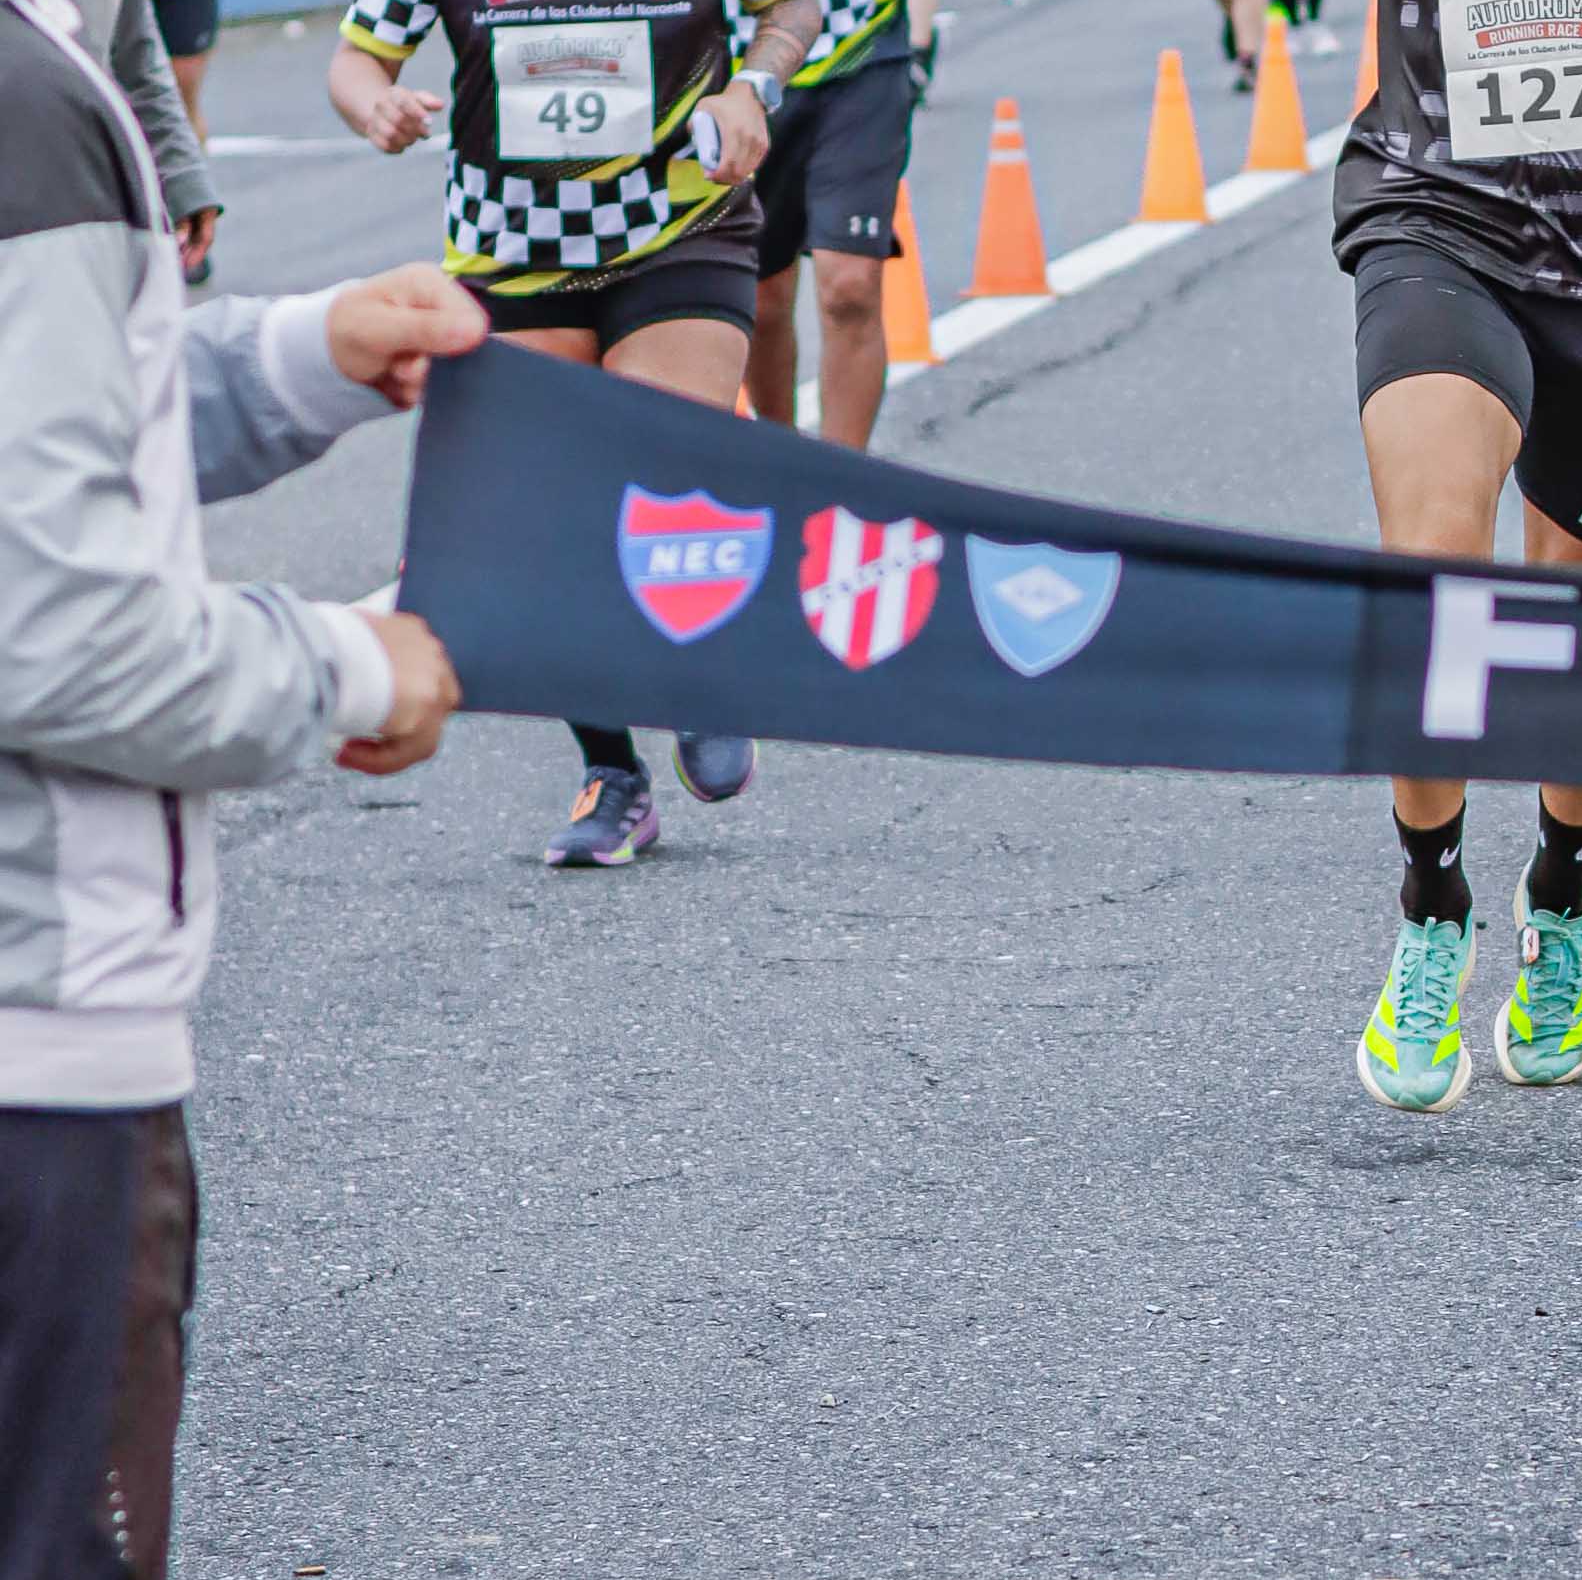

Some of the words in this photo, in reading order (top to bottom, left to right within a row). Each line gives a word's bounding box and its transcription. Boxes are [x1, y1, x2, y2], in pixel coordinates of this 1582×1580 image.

[473, 11, 485, 24] La
[531, 6, 546, 19] de
[549, 5, 567, 18] los
[569, 3, 612, 18] Clubes
[614, 3, 633, 16] del
[636, 1, 692, 16] Noroeste
[1488, 24, 1544, 45] RUNNING
[1547, 23, 1581, 38] RACE
[1467, 52, 1477, 60] La
[1477, 50, 1505, 59] Carrera
[1507, 48, 1517, 57] de
[1518, 47, 1530, 56] los
[1531, 45, 1556, 54] Clubes
[1558, 43, 1570, 52] del
[538, 90, 606, 133] 49
